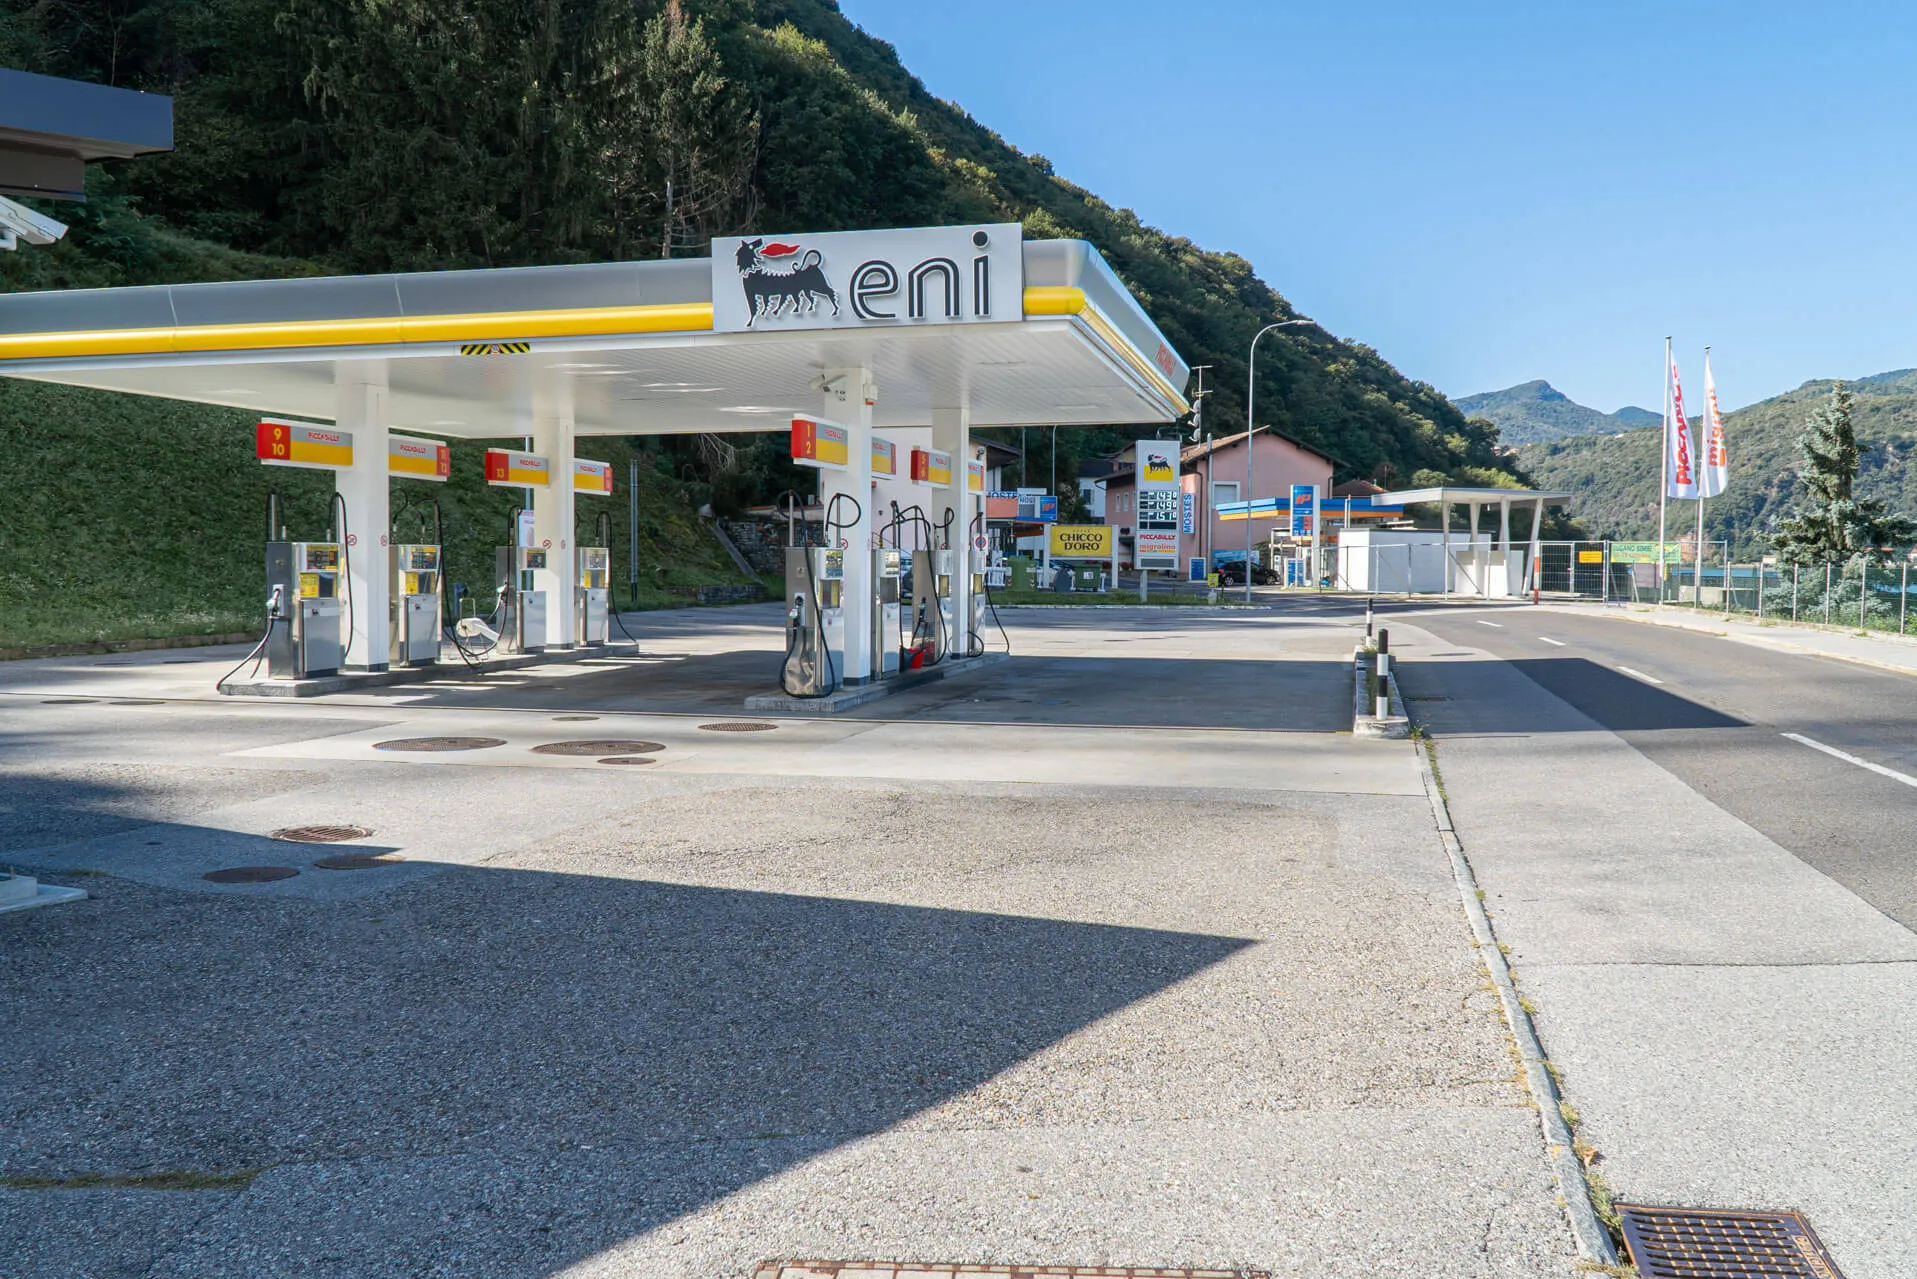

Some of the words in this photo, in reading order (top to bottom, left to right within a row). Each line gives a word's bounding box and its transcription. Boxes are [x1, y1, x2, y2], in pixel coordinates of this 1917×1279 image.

[849, 231, 991, 320] eni
[274, 428, 282, 440] 9
[806, 424, 811, 437] 1
[272, 443, 285, 455] 10
[806, 442, 812, 454] 2
[1183, 494, 1193, 534] MOSTES
[1060, 533, 1103, 542] CHICCO
[1064, 542, 1100, 551] D'ORO
[1139, 543, 1176, 551] migrolino
